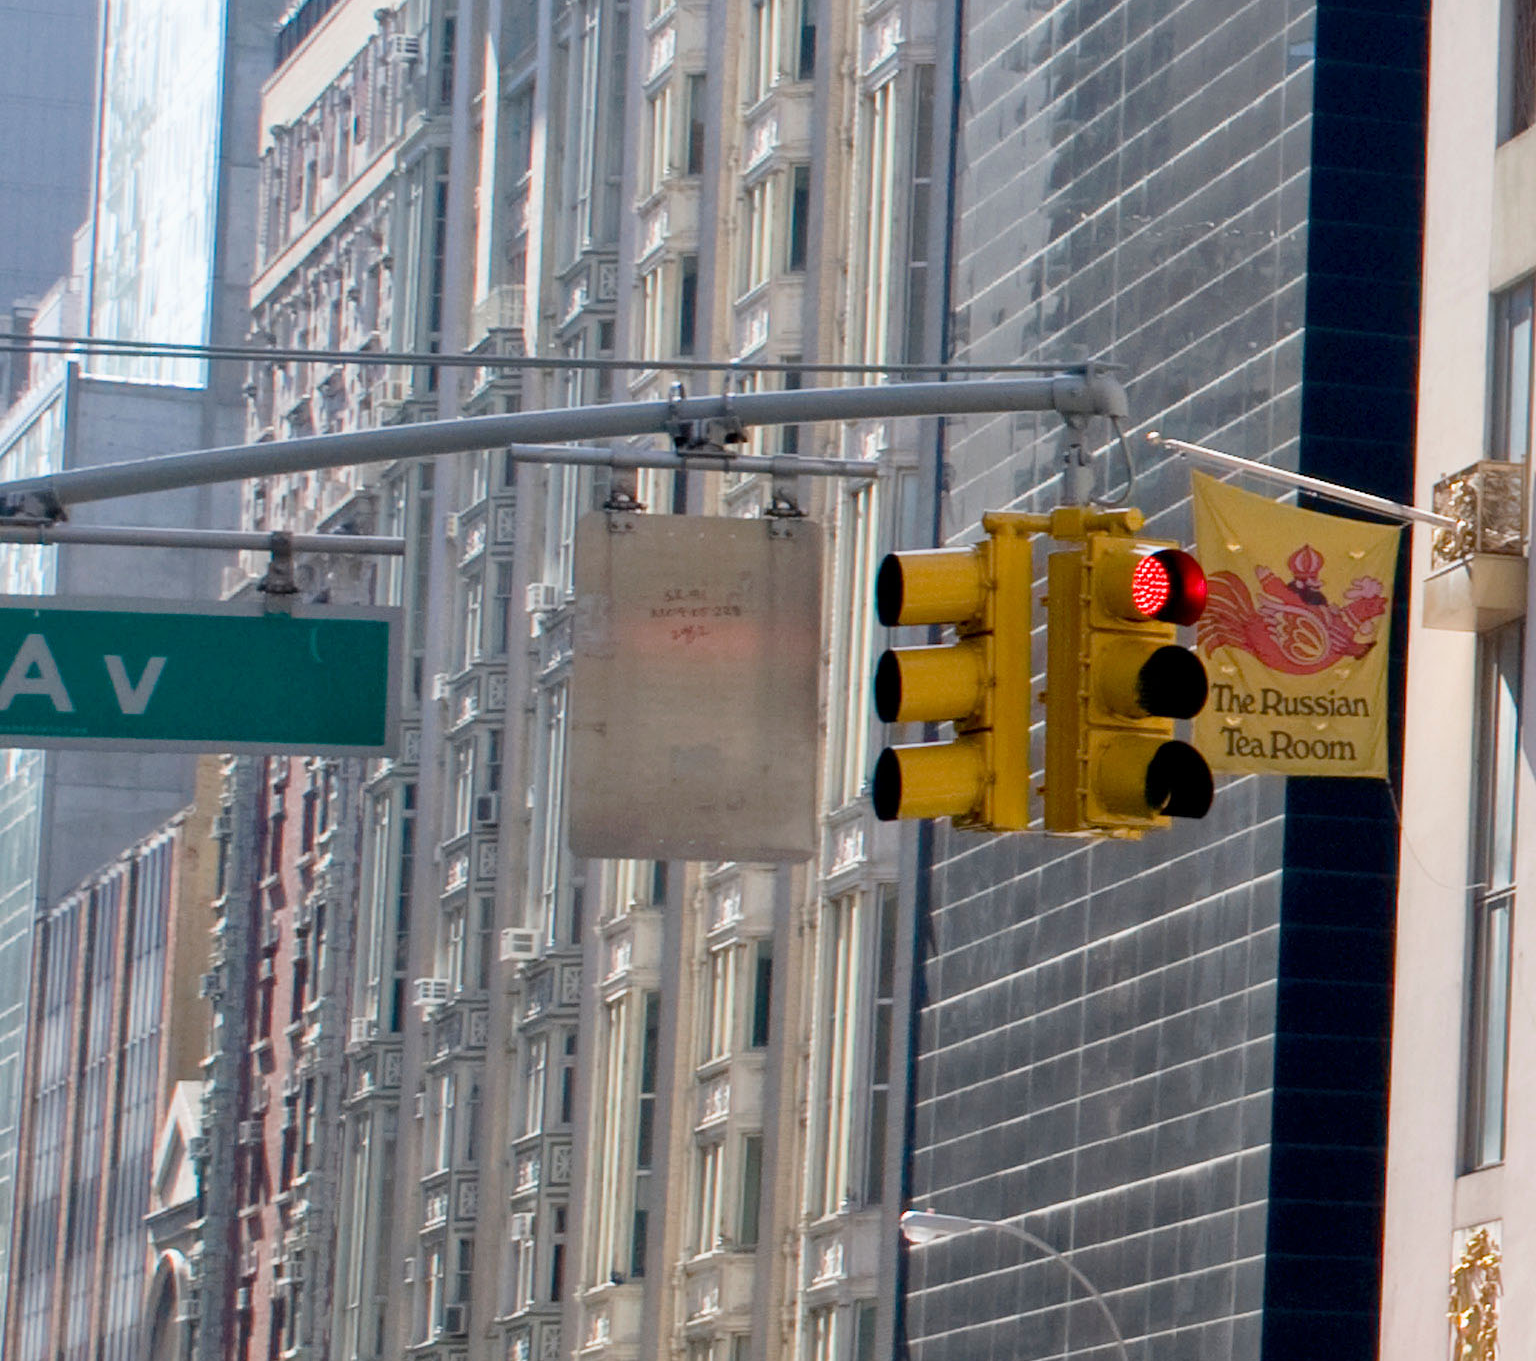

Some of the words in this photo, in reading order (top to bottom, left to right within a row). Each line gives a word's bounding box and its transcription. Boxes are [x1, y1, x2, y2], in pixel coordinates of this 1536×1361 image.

[1212, 683, 1256, 714] The
[1260, 688, 1369, 717] Russian
[1221, 726, 1267, 758] Tea
[1270, 730, 1356, 760] Room
